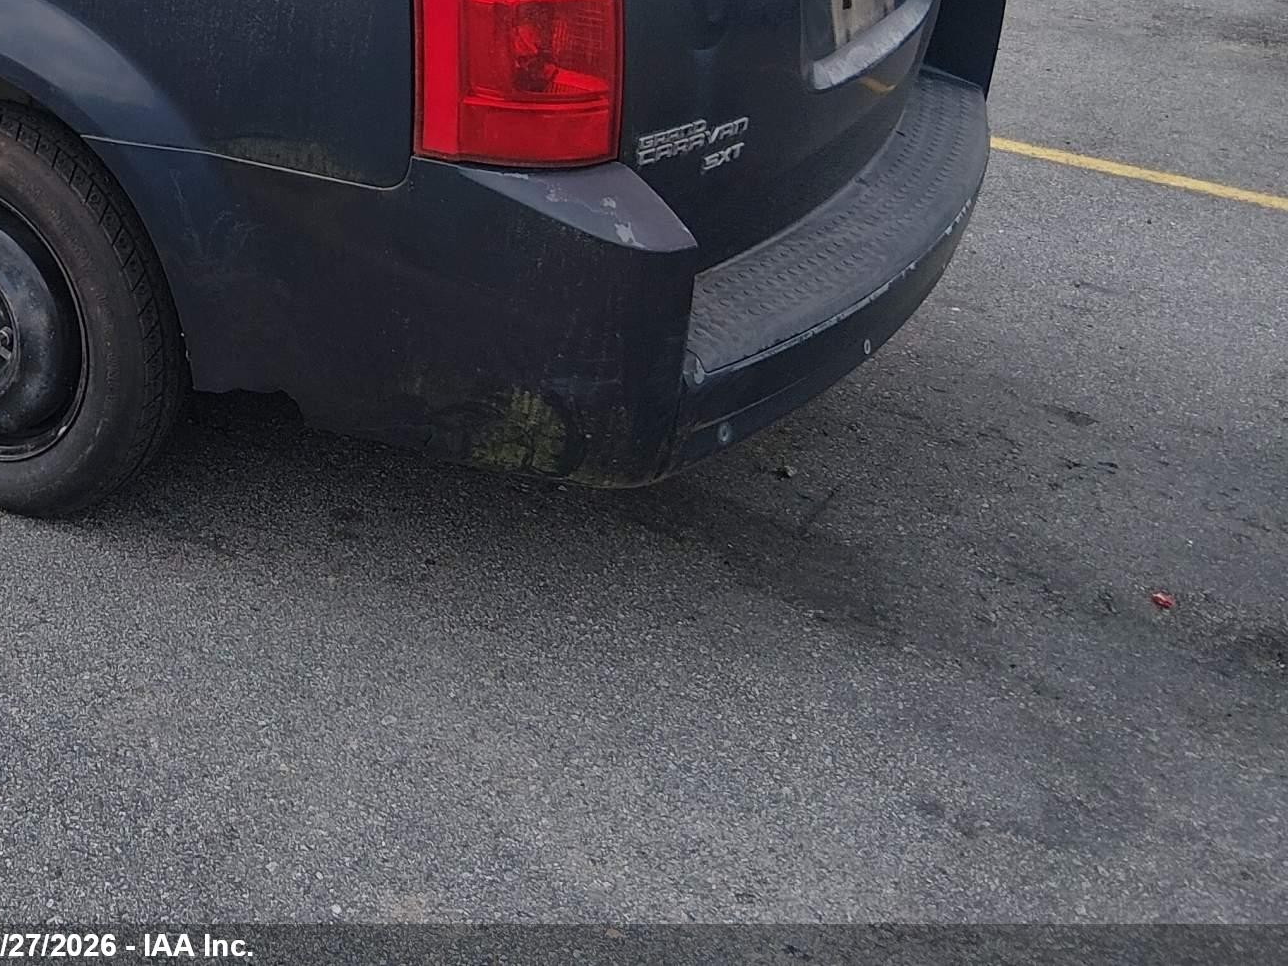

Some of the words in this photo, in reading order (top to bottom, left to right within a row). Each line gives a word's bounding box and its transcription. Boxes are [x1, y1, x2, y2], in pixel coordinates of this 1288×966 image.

[637, 117, 750, 166] CARAVAN
[638, 118, 708, 149] GRAND
[702, 142, 745, 171] SXT
